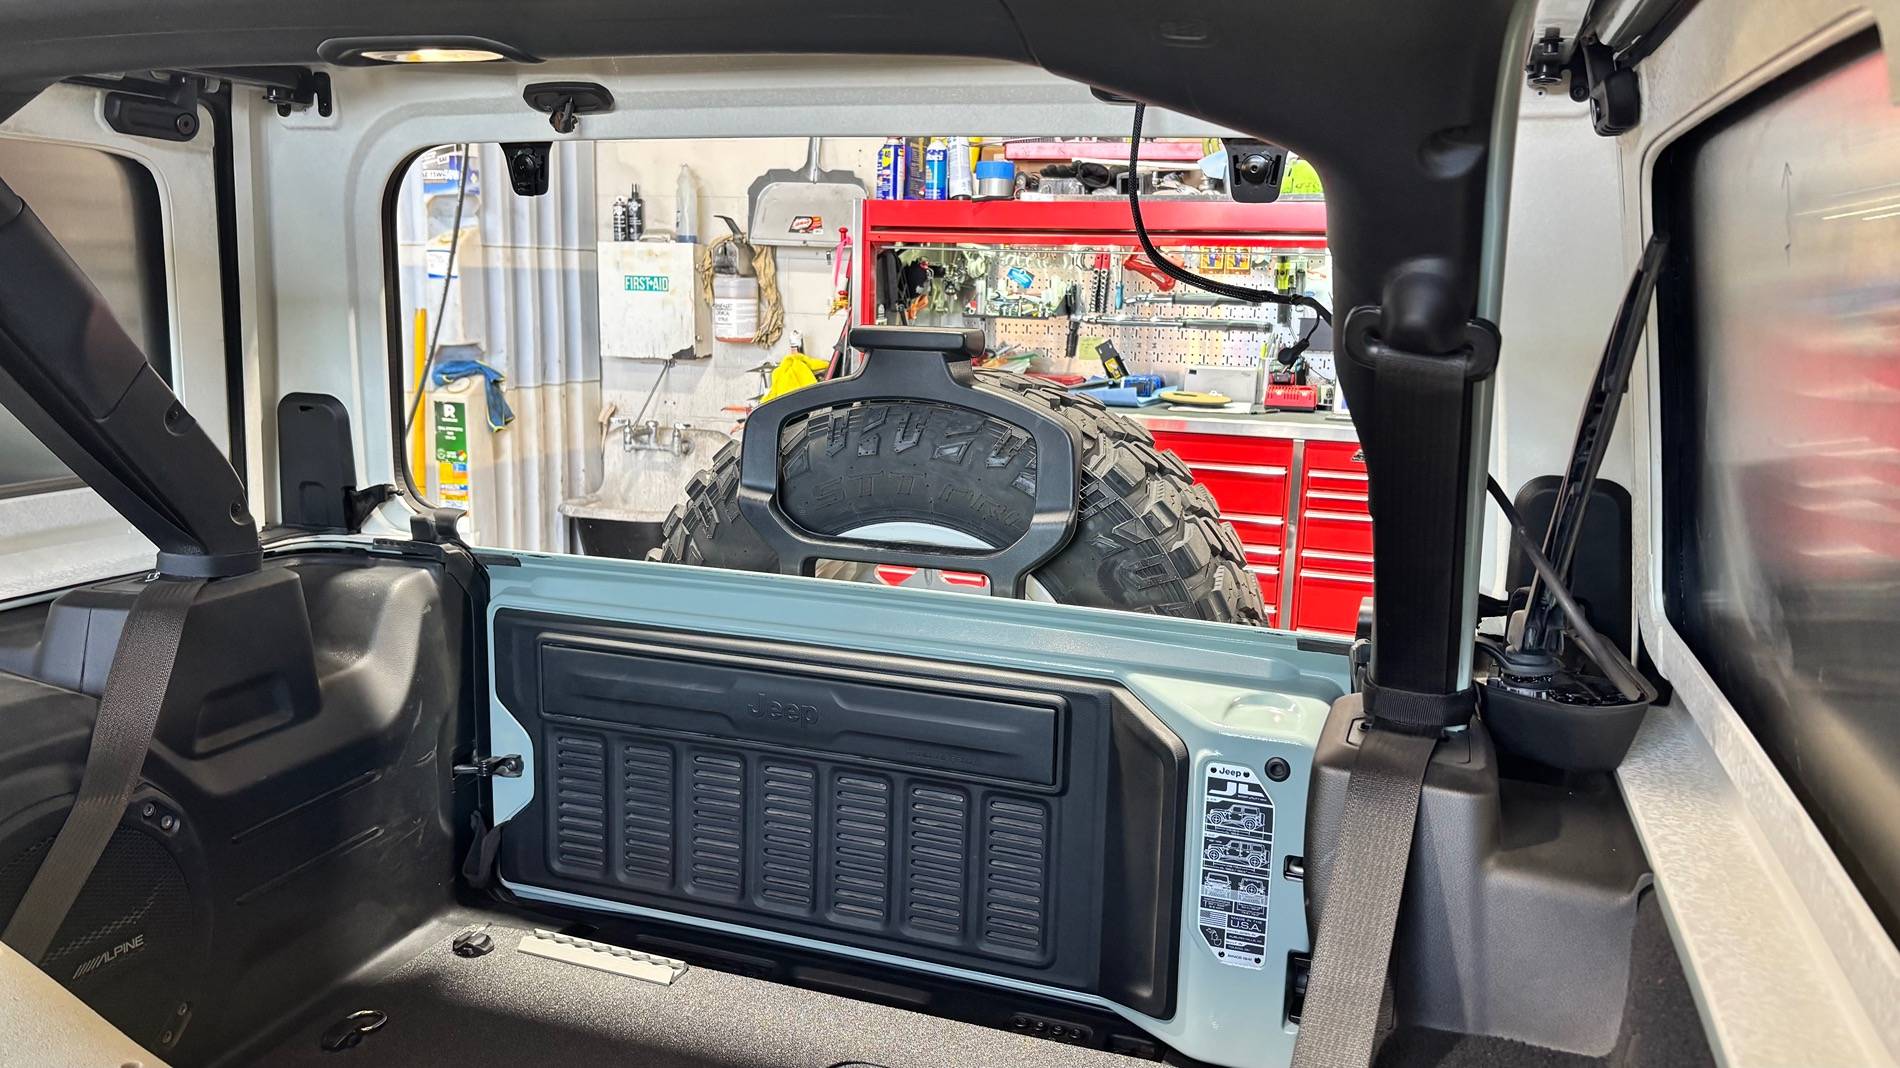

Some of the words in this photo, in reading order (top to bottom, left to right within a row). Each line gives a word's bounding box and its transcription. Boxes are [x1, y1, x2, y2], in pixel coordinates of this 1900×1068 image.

[625, 276, 650, 291] FIRST
[653, 277, 669, 291] AID
[816, 470, 926, 512] STT
[747, 691, 820, 726] Jeep
[1219, 767, 1242, 778] Jeep
[1209, 781, 1265, 798] JL
[1230, 919, 1262, 932] U.S.A.
